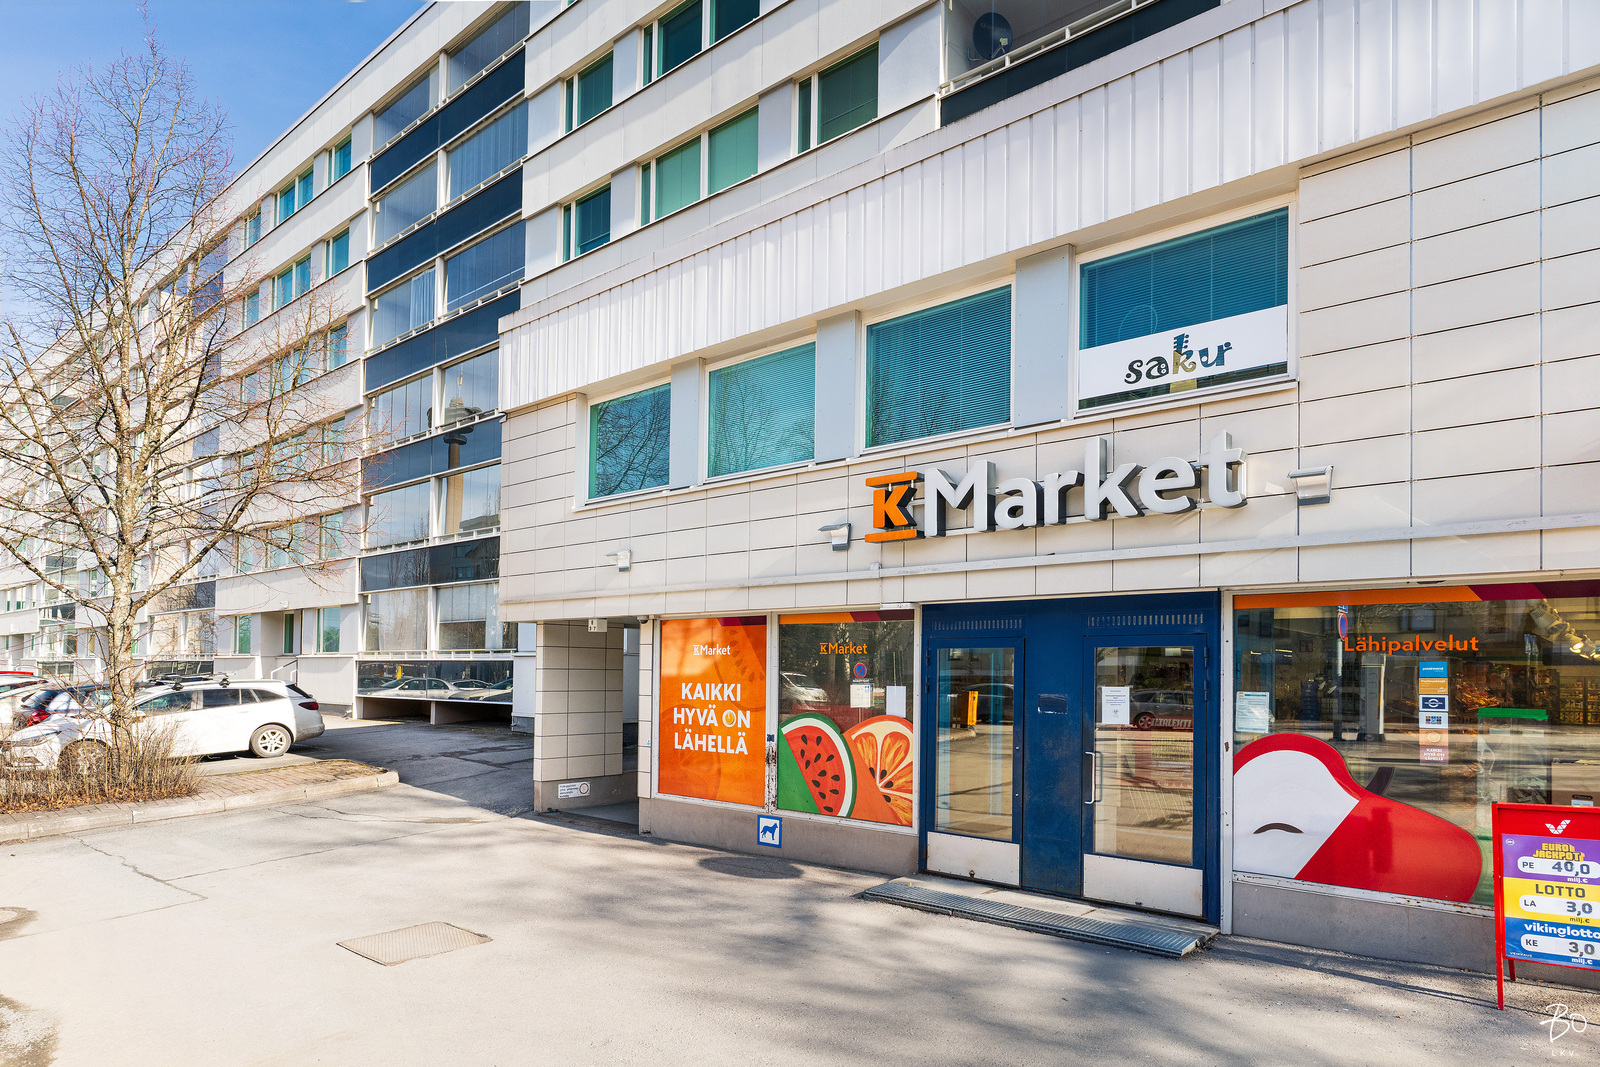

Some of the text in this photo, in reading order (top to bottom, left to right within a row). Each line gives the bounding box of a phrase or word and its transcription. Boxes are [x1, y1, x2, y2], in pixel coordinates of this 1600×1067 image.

[1344, 634, 1479, 656] Lähipalvelut
[681, 682, 741, 702] KAIKKI
[673, 704, 751, 729] HYVÄ ON
[674, 728, 748, 755] LÄHELLÄ
[1532, 849, 1585, 862] JACKPOT
[1542, 843, 1575, 853] EURO
[1522, 861, 1590, 877] PE 40,0
[1535, 883, 1586, 898] LOTTO
[1523, 899, 1593, 917] LA 3,0
[1523, 922, 1600, 939] vikinglotto
[1525, 939, 1596, 957] KE 3,0
